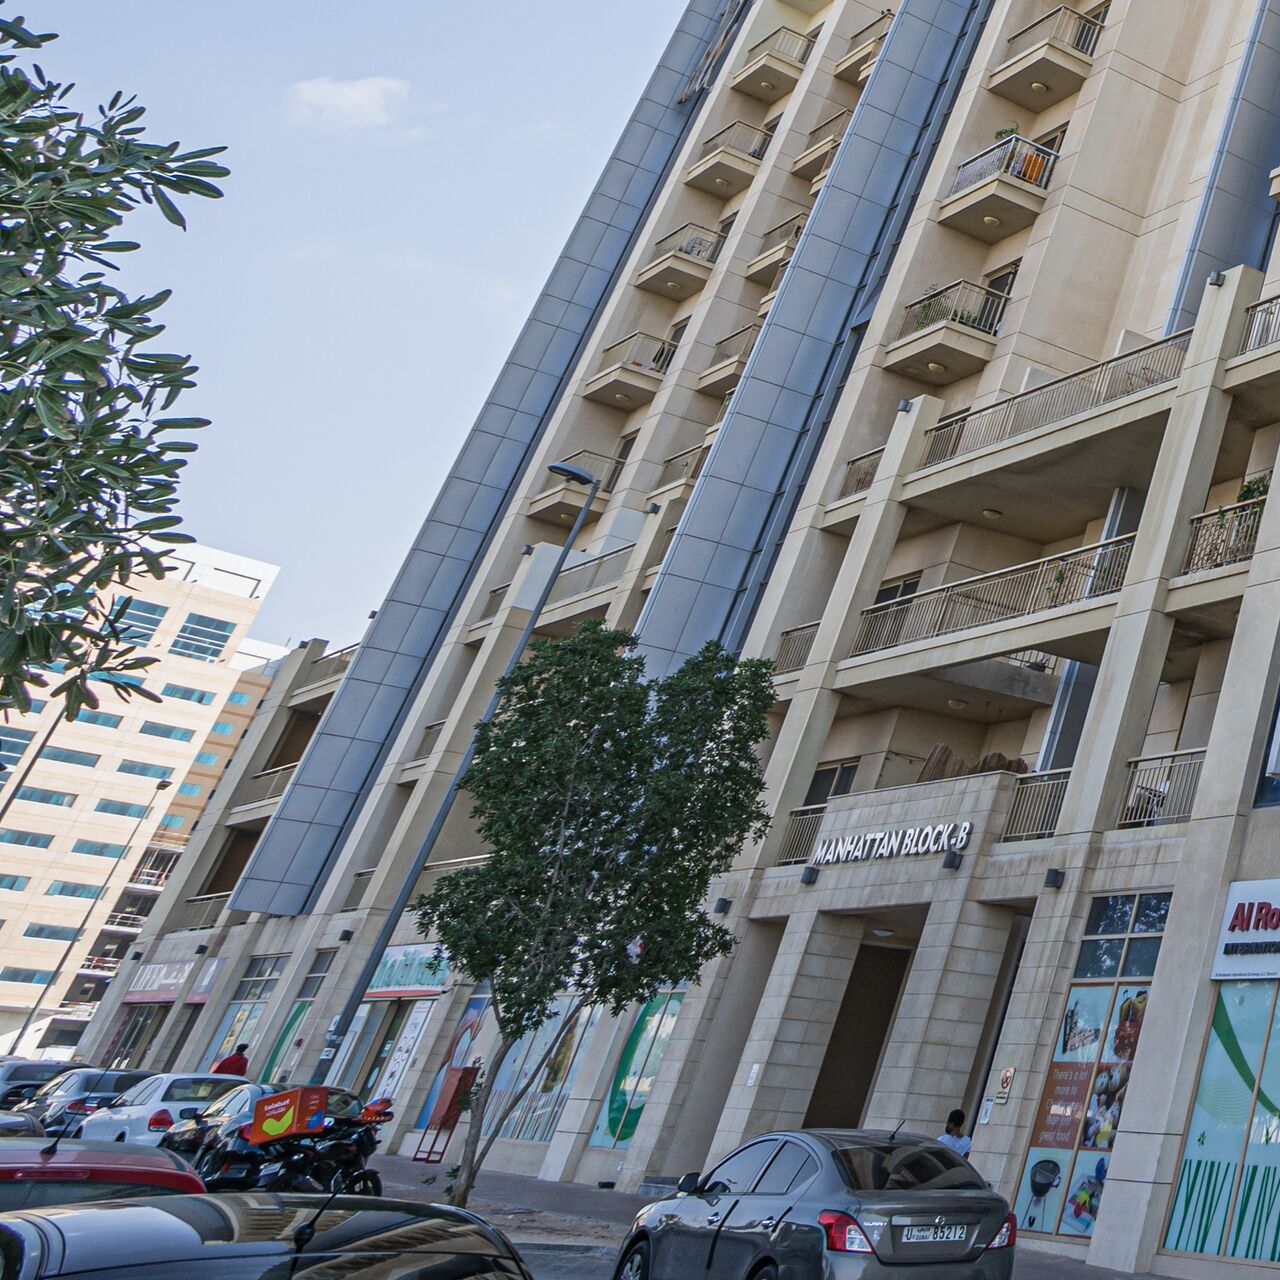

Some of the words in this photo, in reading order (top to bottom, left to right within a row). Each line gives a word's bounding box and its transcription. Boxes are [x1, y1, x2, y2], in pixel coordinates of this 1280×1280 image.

[813, 830, 902, 865] MANHATTAN
[1228, 902, 1255, 932] Al
[932, 1226, 965, 1240] 85212
